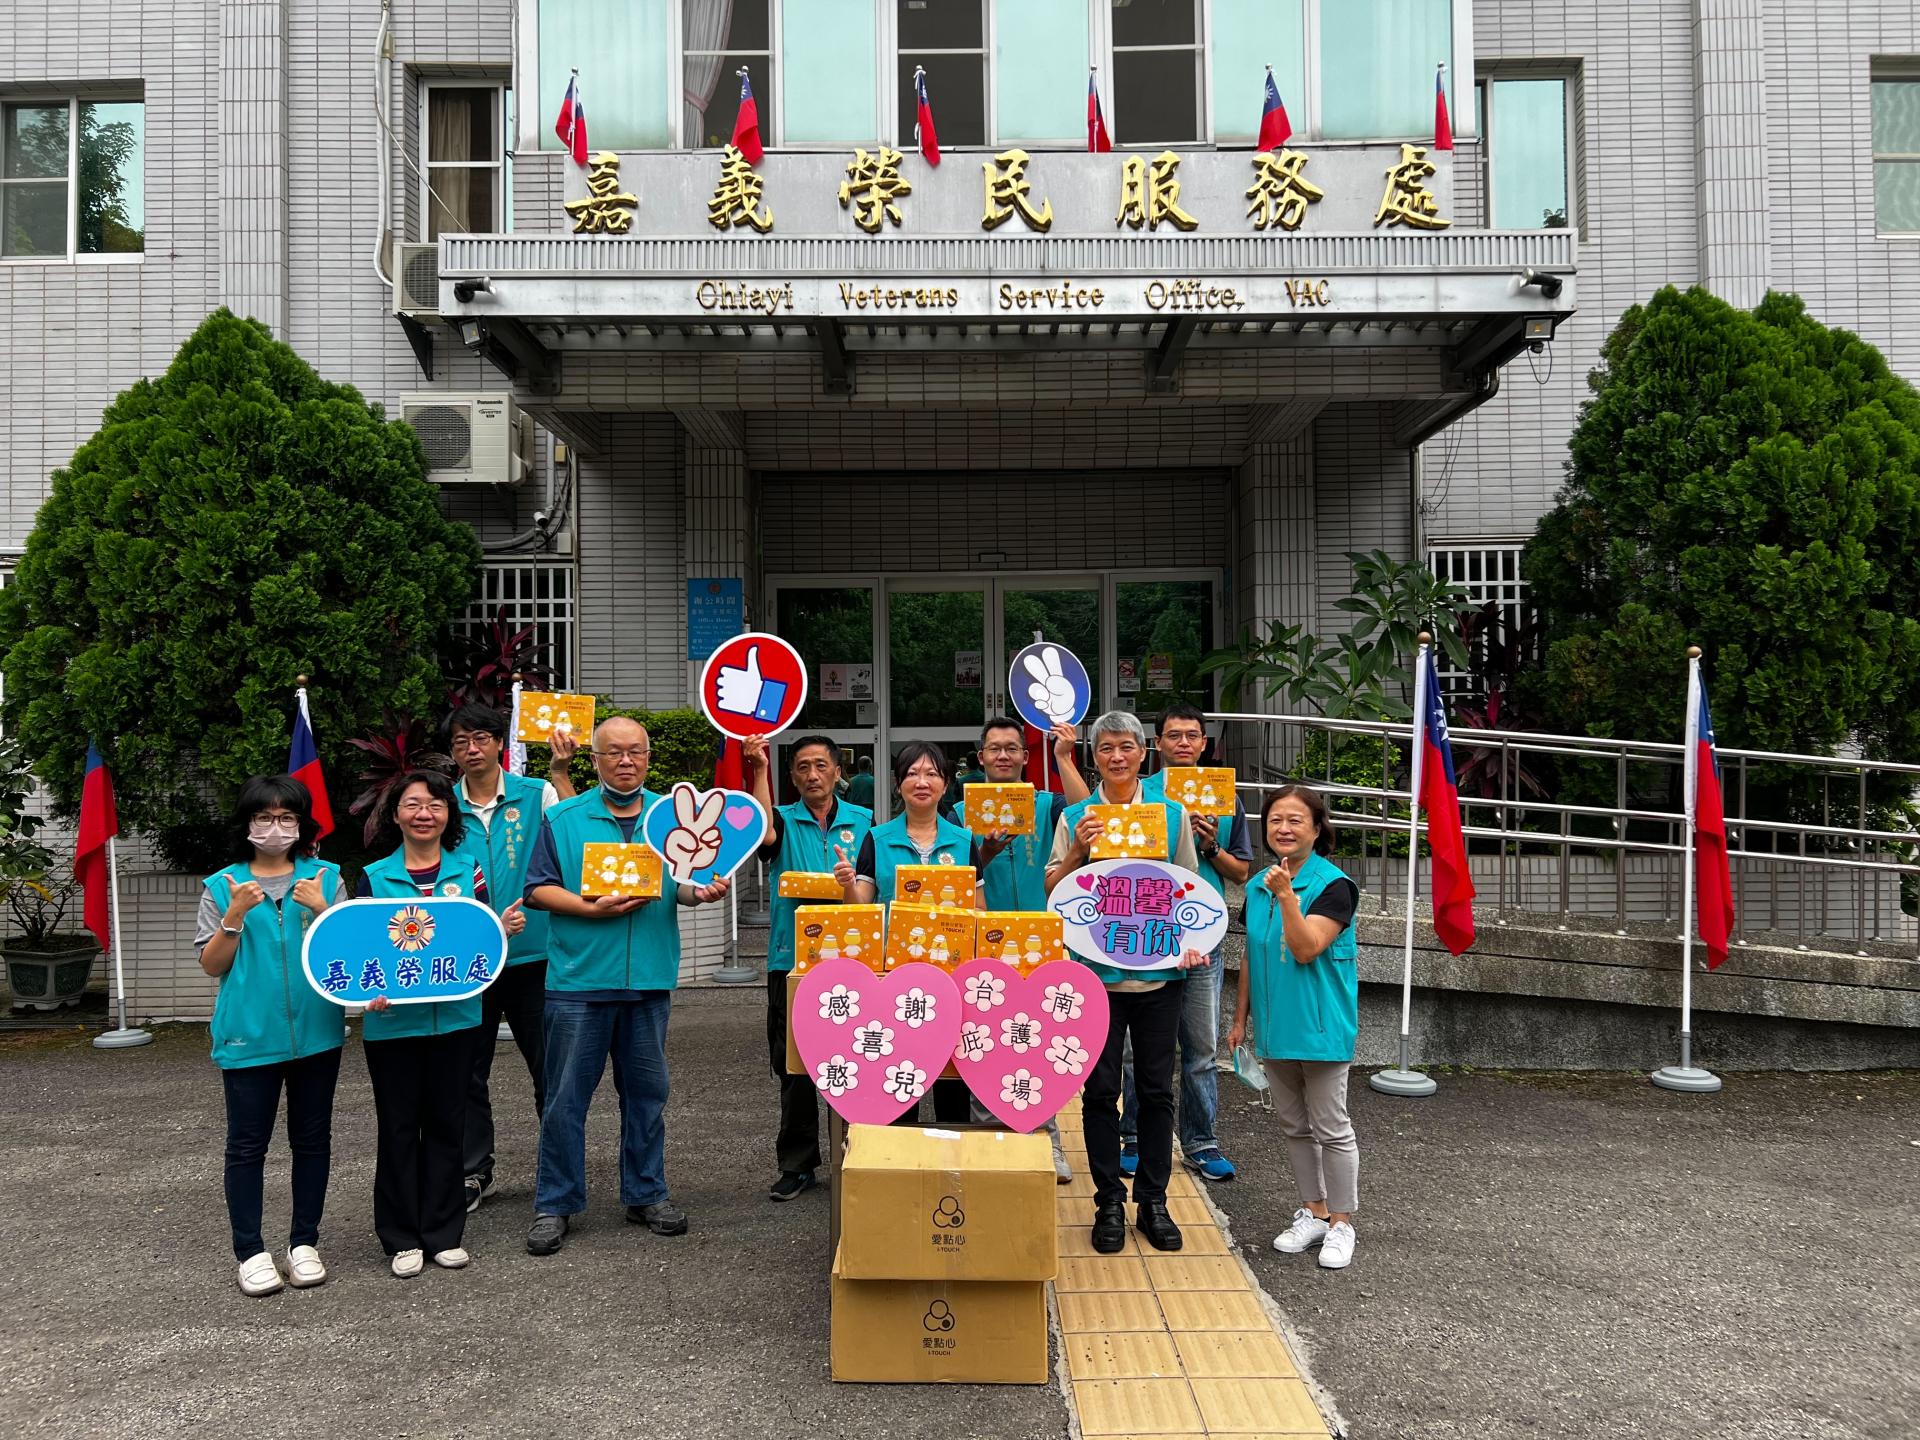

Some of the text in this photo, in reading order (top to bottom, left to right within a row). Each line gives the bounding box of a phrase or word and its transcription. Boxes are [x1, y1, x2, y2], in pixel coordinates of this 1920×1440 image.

[564, 144, 1453, 233] 嘉義榮民服務處
[698, 281, 793, 315] Chiayi
[839, 282, 958, 309] Veterans
[999, 282, 1104, 310] Service
[1285, 279, 1330, 308] VAC
[1095, 875, 1173, 917] 溫馨
[1103, 918, 1181, 957] 有你
[321, 954, 493, 993] 嘉義榮服處
[931, 1234, 966, 1246] 愛點心
[922, 1337, 956, 1349] 愛點心
